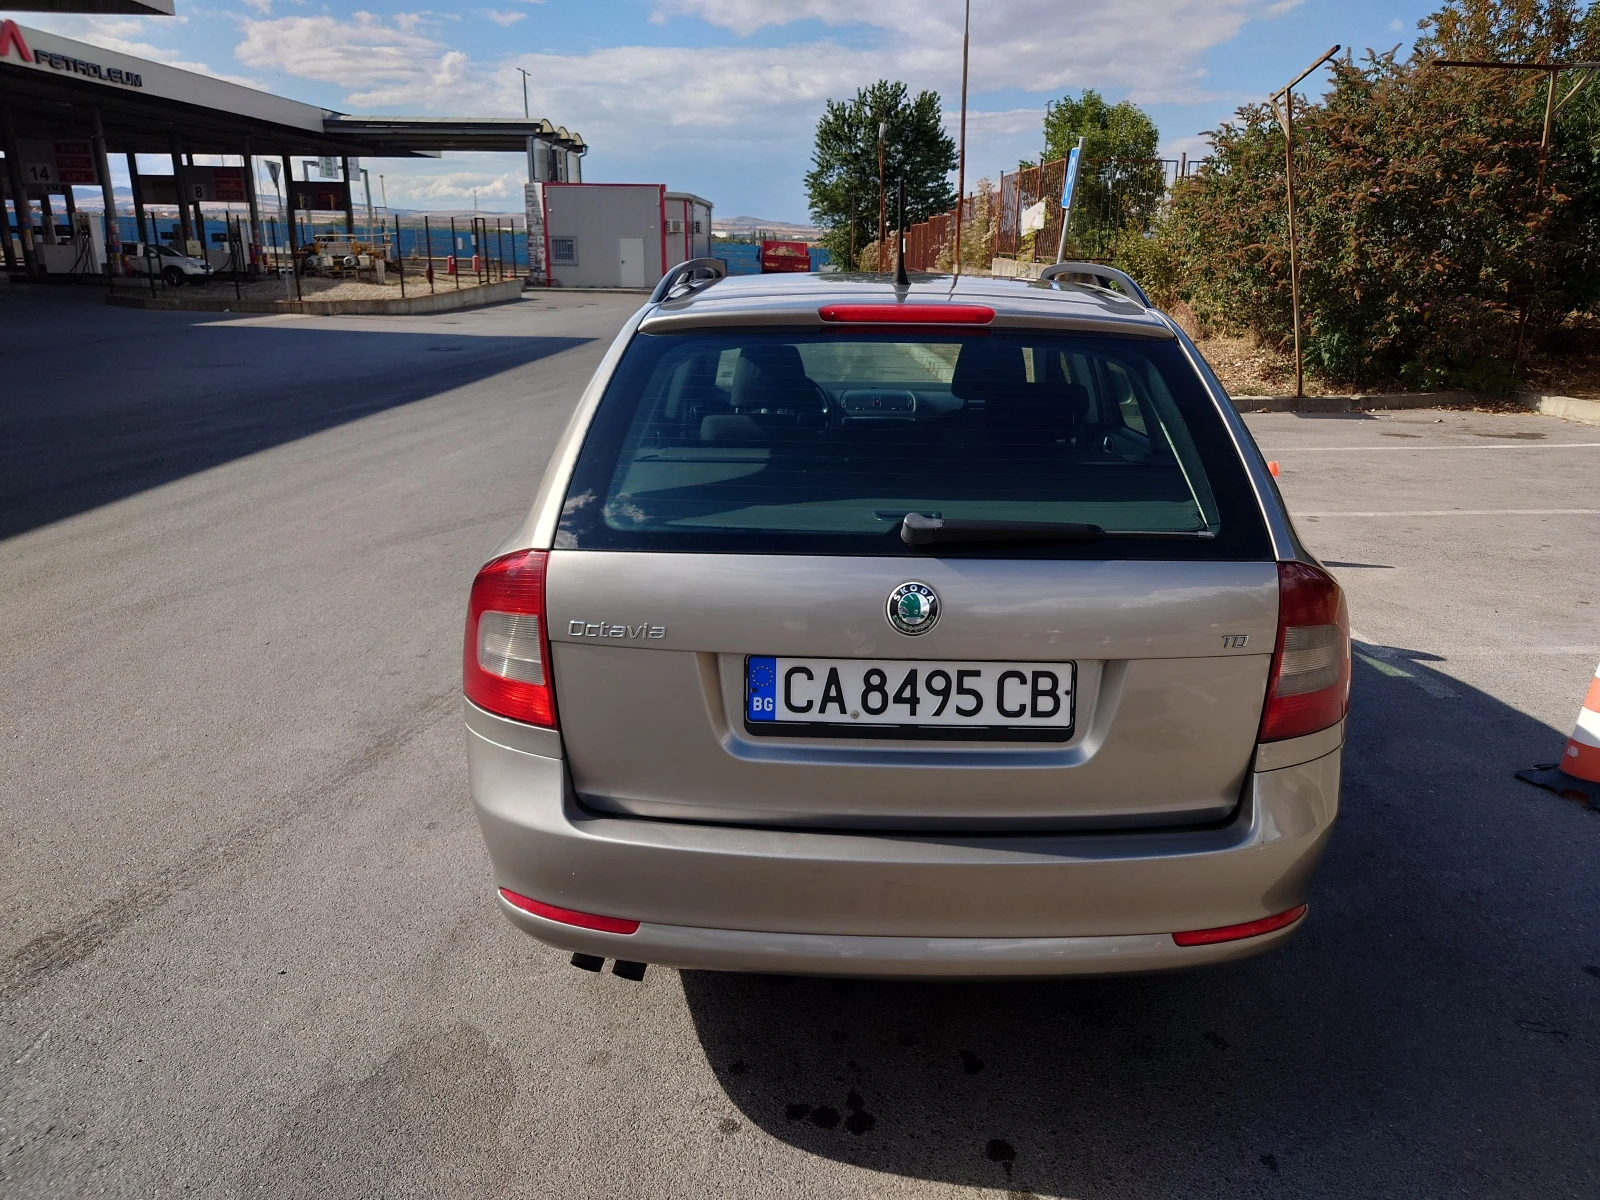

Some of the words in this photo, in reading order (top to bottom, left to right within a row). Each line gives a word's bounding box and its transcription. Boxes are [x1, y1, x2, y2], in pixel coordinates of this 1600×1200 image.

[33, 49, 143, 87] PETROLEUM
[30, 166, 50, 181] 14
[67, 172, 85, 181] LPG
[195, 186, 203, 199] 8
[893, 584, 935, 604] SKODA
[568, 620, 667, 639] Octavia
[784, 666, 847, 714] CA
[861, 668, 984, 718] 8495
[996, 670, 1060, 718] CB
[753, 697, 773, 711] BG
